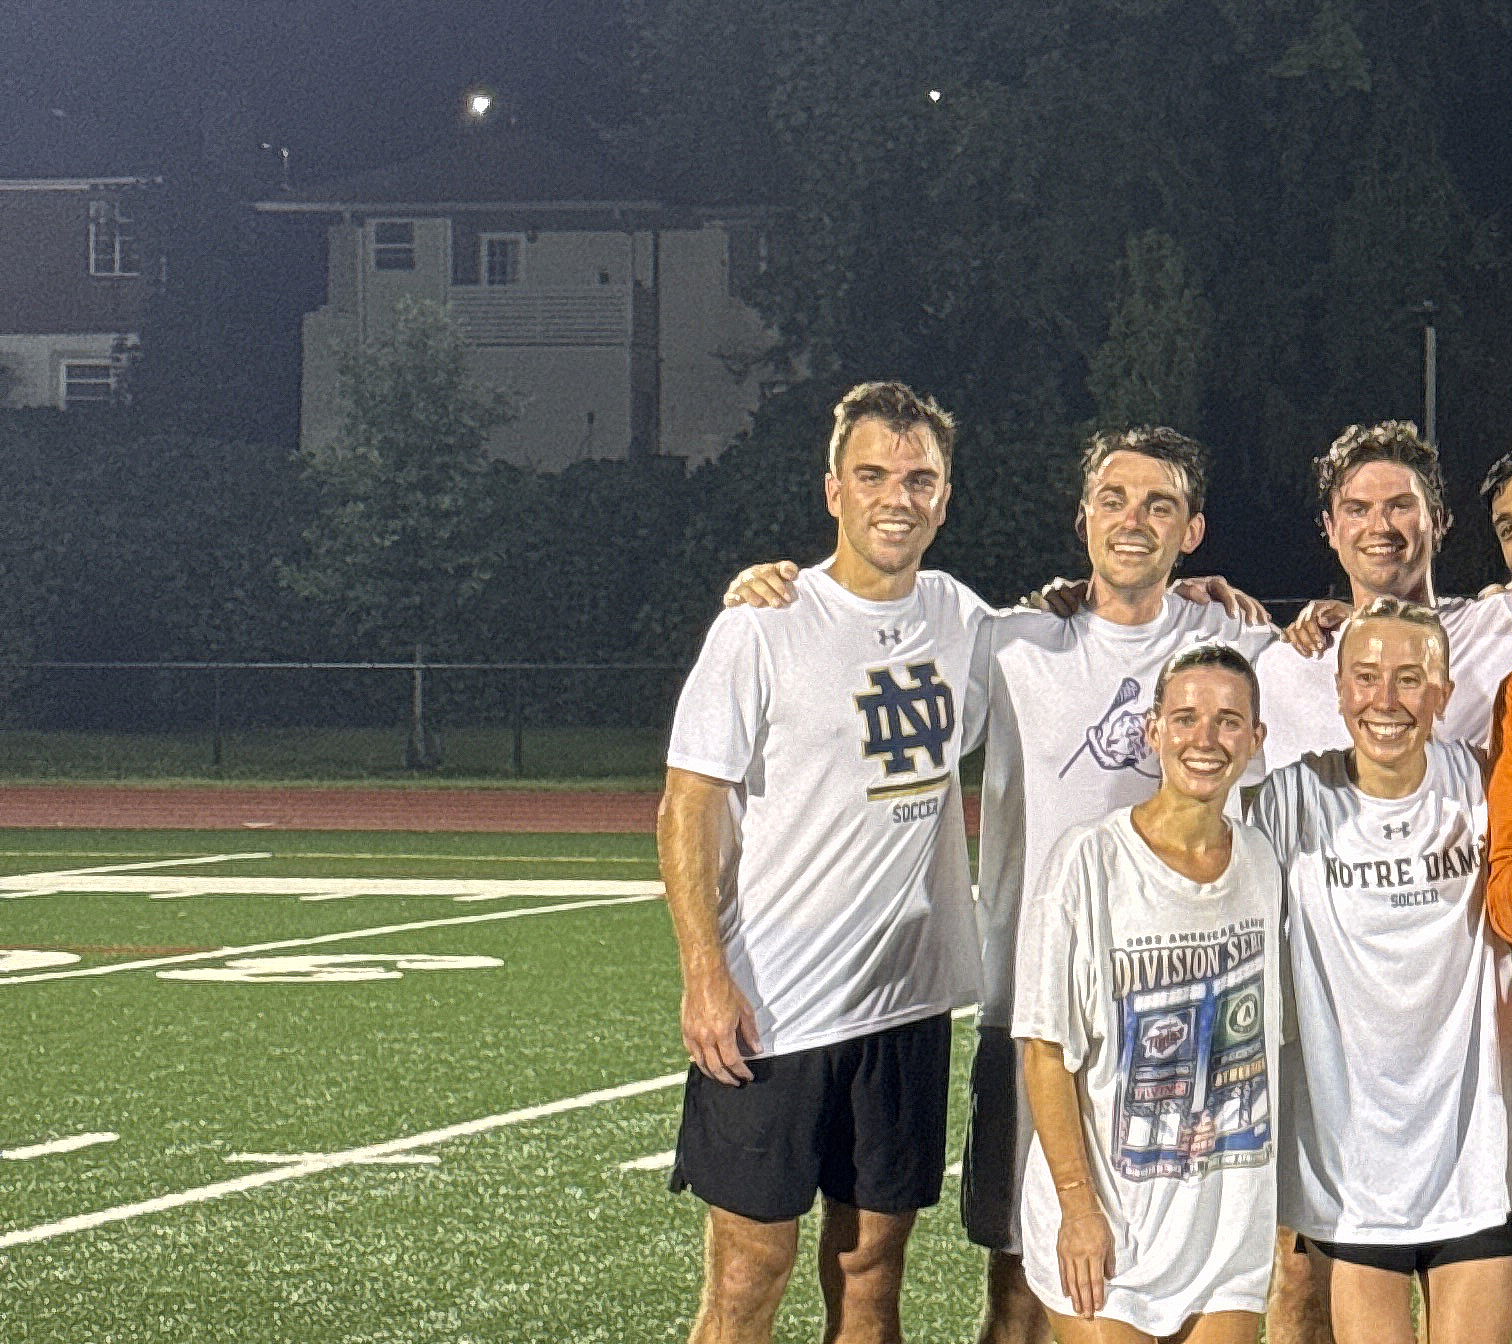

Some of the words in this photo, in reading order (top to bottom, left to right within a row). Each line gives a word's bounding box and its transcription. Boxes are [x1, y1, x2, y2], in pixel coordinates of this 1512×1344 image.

[1326, 857, 1414, 889] NOTRE
[1390, 887, 1440, 909] SOCCER
[1111, 943, 1221, 999] DIVISION
